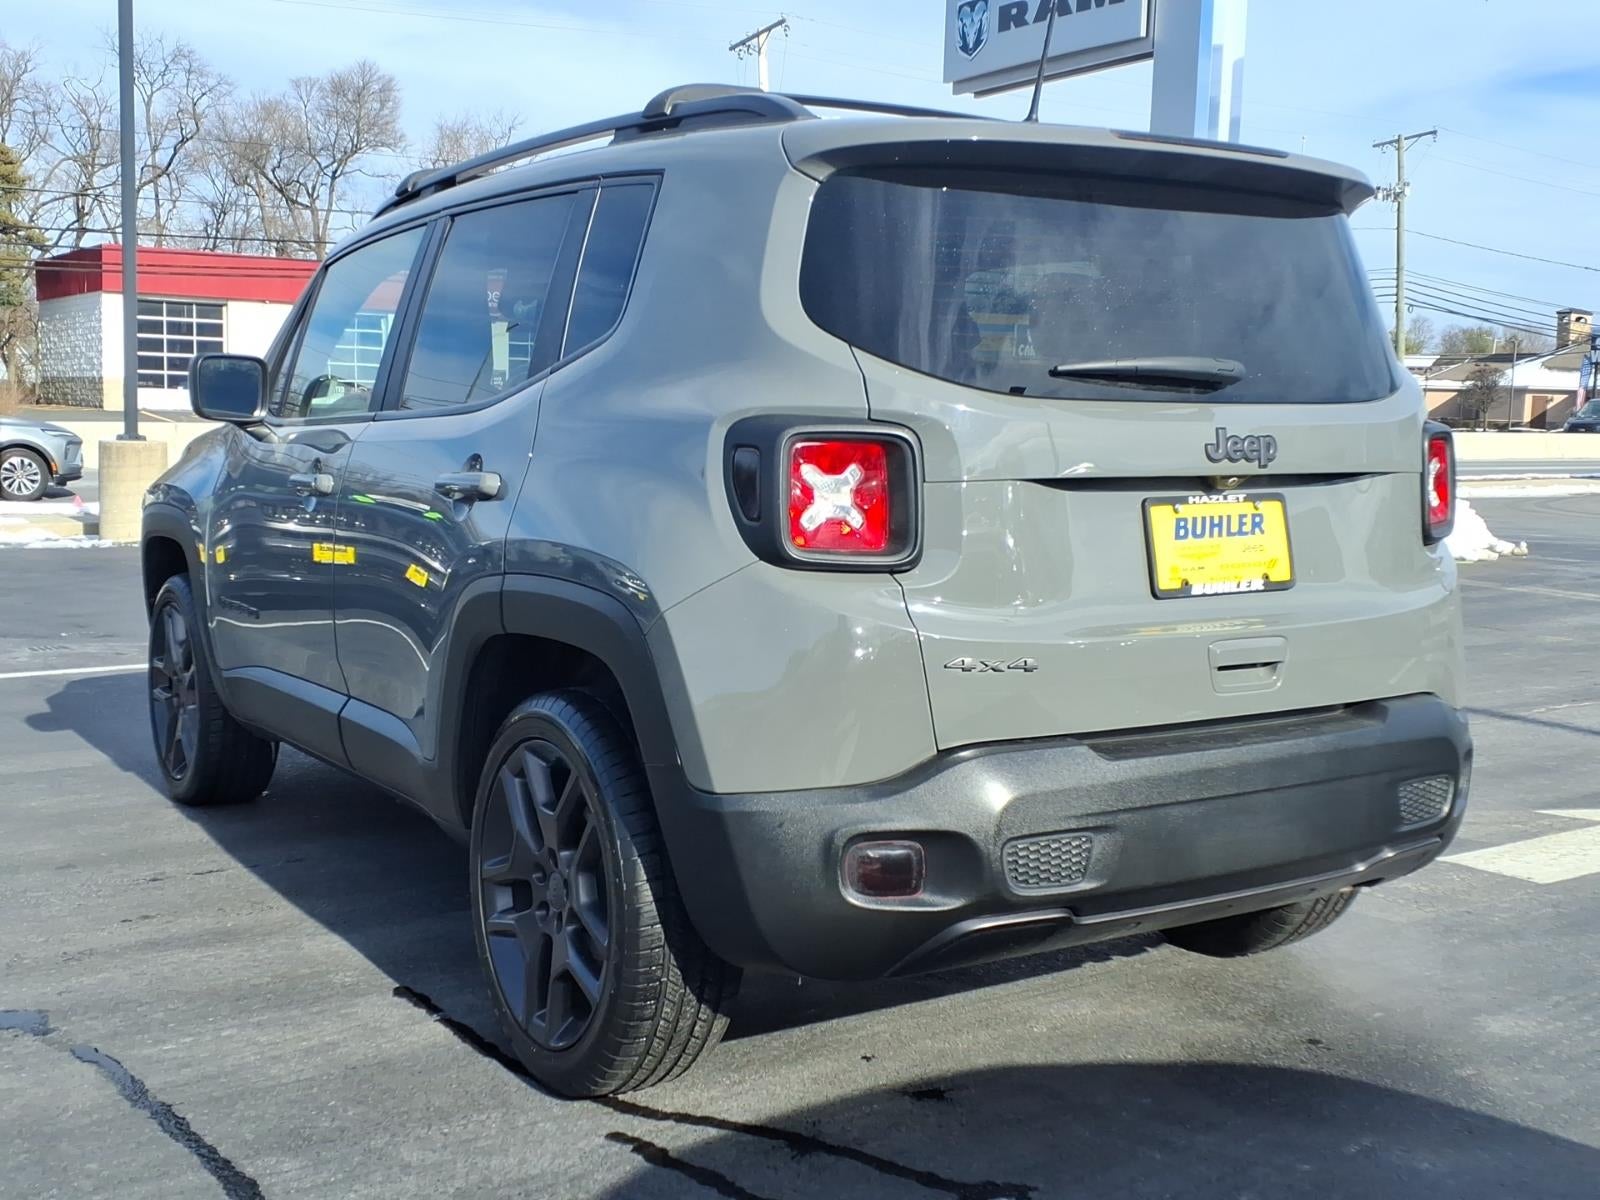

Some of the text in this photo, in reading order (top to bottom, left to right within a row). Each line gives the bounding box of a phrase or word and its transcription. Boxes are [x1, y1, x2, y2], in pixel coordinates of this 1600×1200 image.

[1205, 427, 1277, 469] Jeep
[1188, 494, 1247, 504] HAZLET
[1174, 513, 1265, 541] BUHLER
